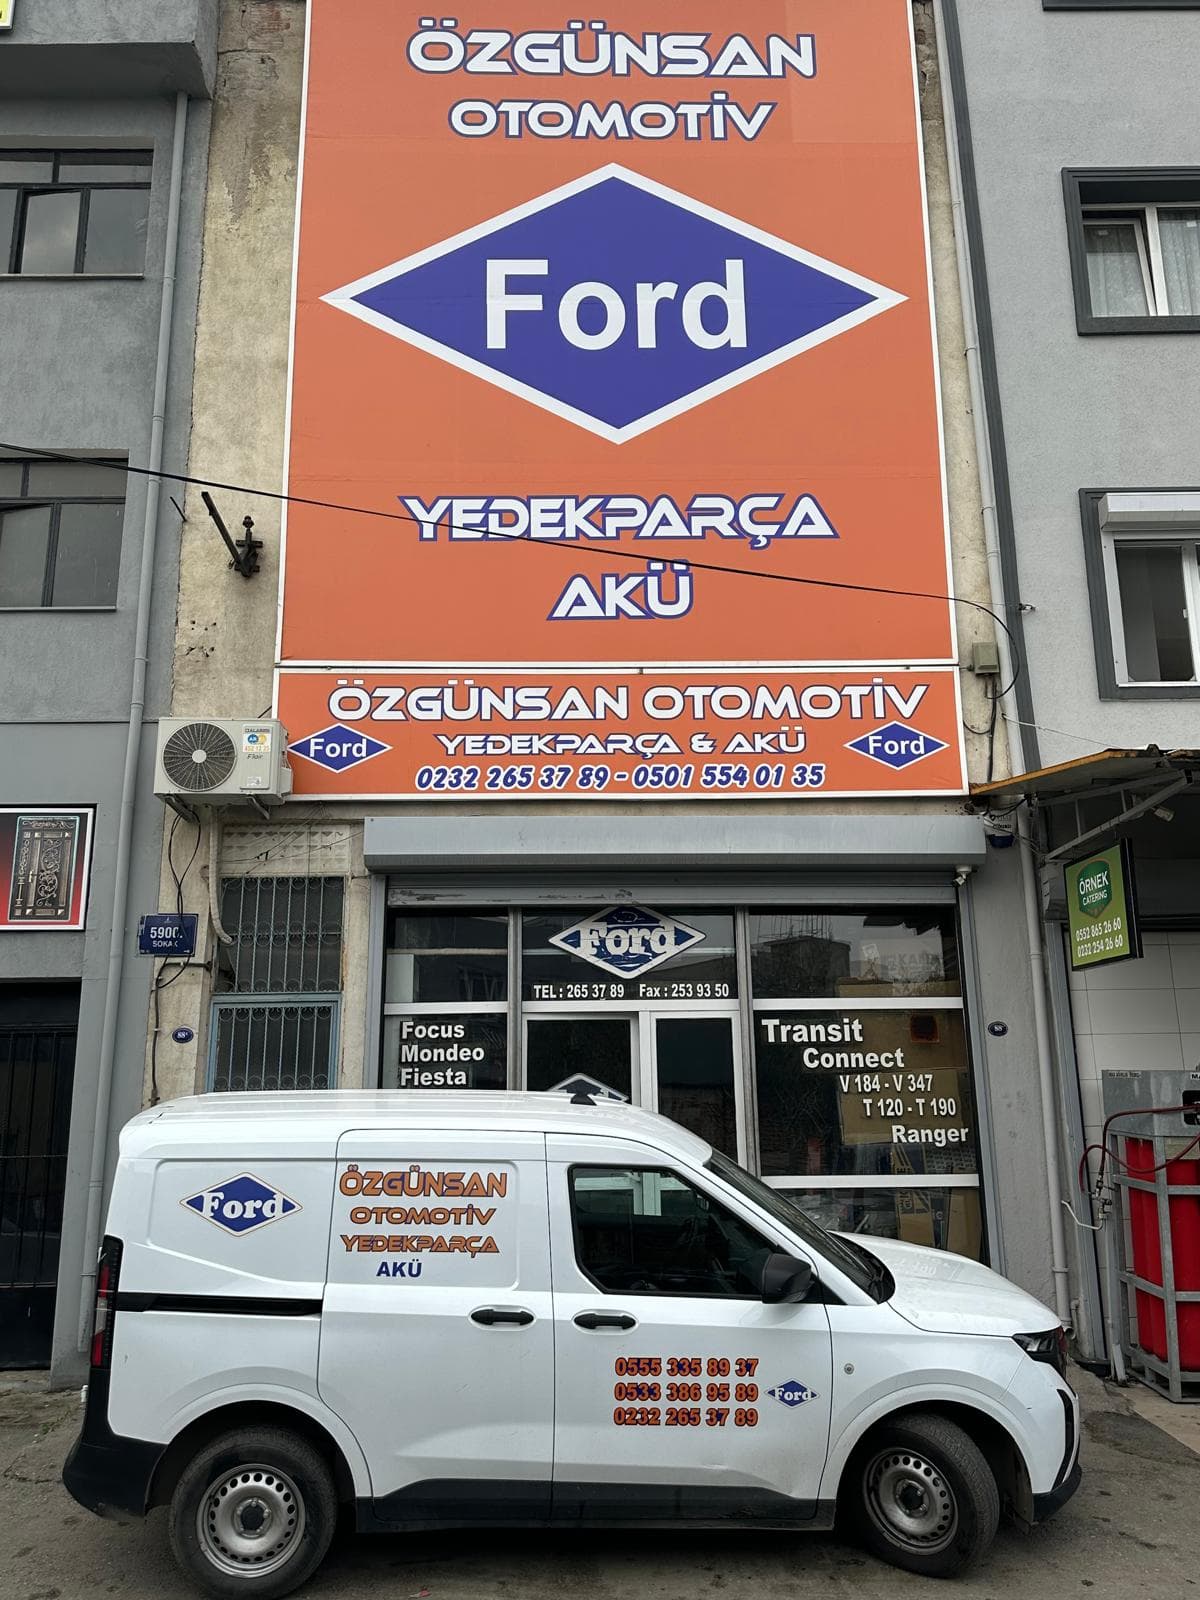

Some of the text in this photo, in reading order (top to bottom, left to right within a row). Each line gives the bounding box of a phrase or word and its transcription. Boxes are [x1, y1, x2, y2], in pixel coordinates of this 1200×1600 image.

[406, 17, 816, 78] ÖZGÜNSAN
[448, 91, 777, 140] OTOMOTİV
[486, 259, 748, 350] Ford
[397, 493, 840, 549] YEDEKPARÇA
[546, 559, 693, 620] AKÜ
[328, 677, 929, 721] ÖZGÜNSAN OTOMOTİV
[309, 738, 367, 758] Ford
[433, 726, 807, 759] YEDEKPARÇA & AKÜ
[868, 735, 925, 755] Ford
[415, 765, 480, 791] 0232
[484, 765, 534, 790] 265
[539, 765, 572, 789] 37
[576, 764, 609, 790] 89
[632, 764, 694, 789] 0501
[700, 764, 749, 788] 554
[754, 763, 784, 787] 01
[792, 763, 825, 787] 35
[1079, 871, 1109, 895] ÖRNEK
[1082, 890, 1108, 906] CATERING
[577, 919, 676, 956] Ford
[534, 985, 556, 998] TEL
[566, 984, 589, 998] 265
[592, 984, 606, 998] 37
[610, 984, 625, 998] 89
[639, 984, 660, 997] Fax
[672, 984, 693, 997] 253
[697, 984, 712, 997] 93
[715, 983, 729, 997] 50
[402, 1021, 465, 1039] Focus
[761, 1018, 863, 1043] Transit
[401, 1043, 485, 1062] Mondeo
[803, 1047, 904, 1068] Connect
[401, 1067, 467, 1086] Fiesta
[840, 1075, 849, 1092] V
[854, 1075, 880, 1092] 184
[893, 1075, 903, 1092] V
[907, 1074, 933, 1091] 347
[863, 1099, 873, 1116] T
[877, 1098, 903, 1116] 120
[916, 1098, 925, 1115] T
[930, 1098, 956, 1115] 190
[891, 1125, 968, 1146] Ranger
[339, 1165, 507, 1197] ÖZGÜNSAN
[201, 1191, 284, 1219] Ford
[350, 1204, 497, 1225] OTOMOTİV
[340, 1235, 500, 1258] YEDEKPARÇA
[376, 1259, 422, 1278] AKÜ
[615, 1357, 759, 1377] 0555 335 89 37
[614, 1382, 758, 1402] 0533 386 95 89
[774, 1387, 812, 1402] Ford
[613, 1407, 758, 1426] 0232 265 37 89
